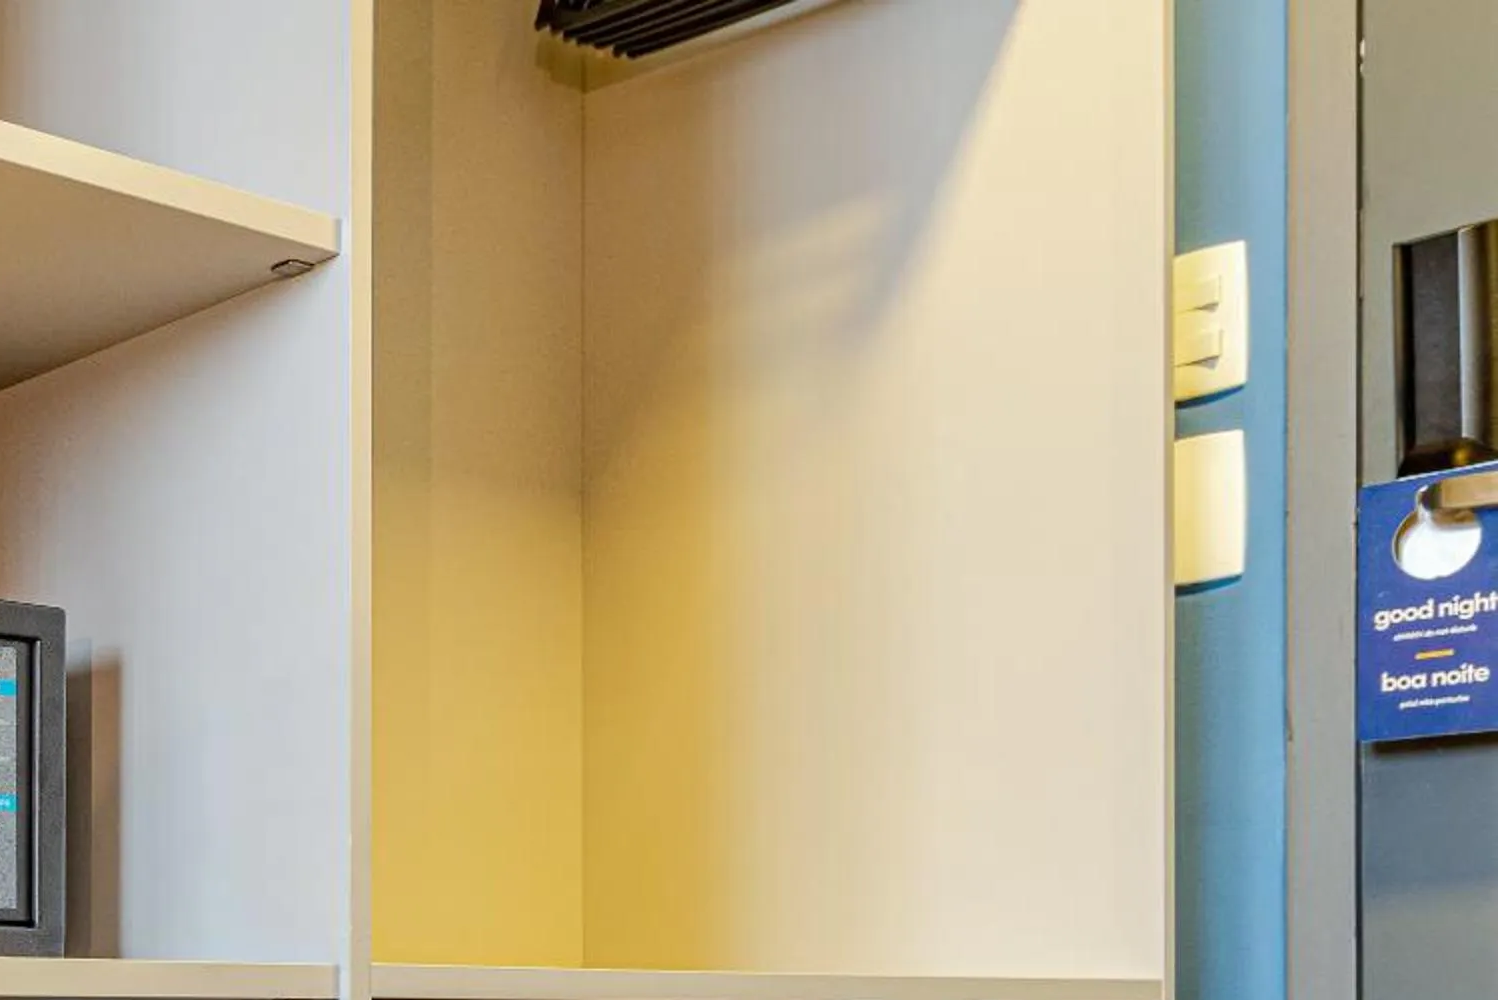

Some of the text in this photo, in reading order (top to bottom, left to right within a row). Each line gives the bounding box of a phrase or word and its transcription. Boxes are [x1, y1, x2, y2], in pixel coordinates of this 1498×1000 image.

[1373, 590, 1498, 631] good night
[1380, 661, 1491, 693] boa noite
